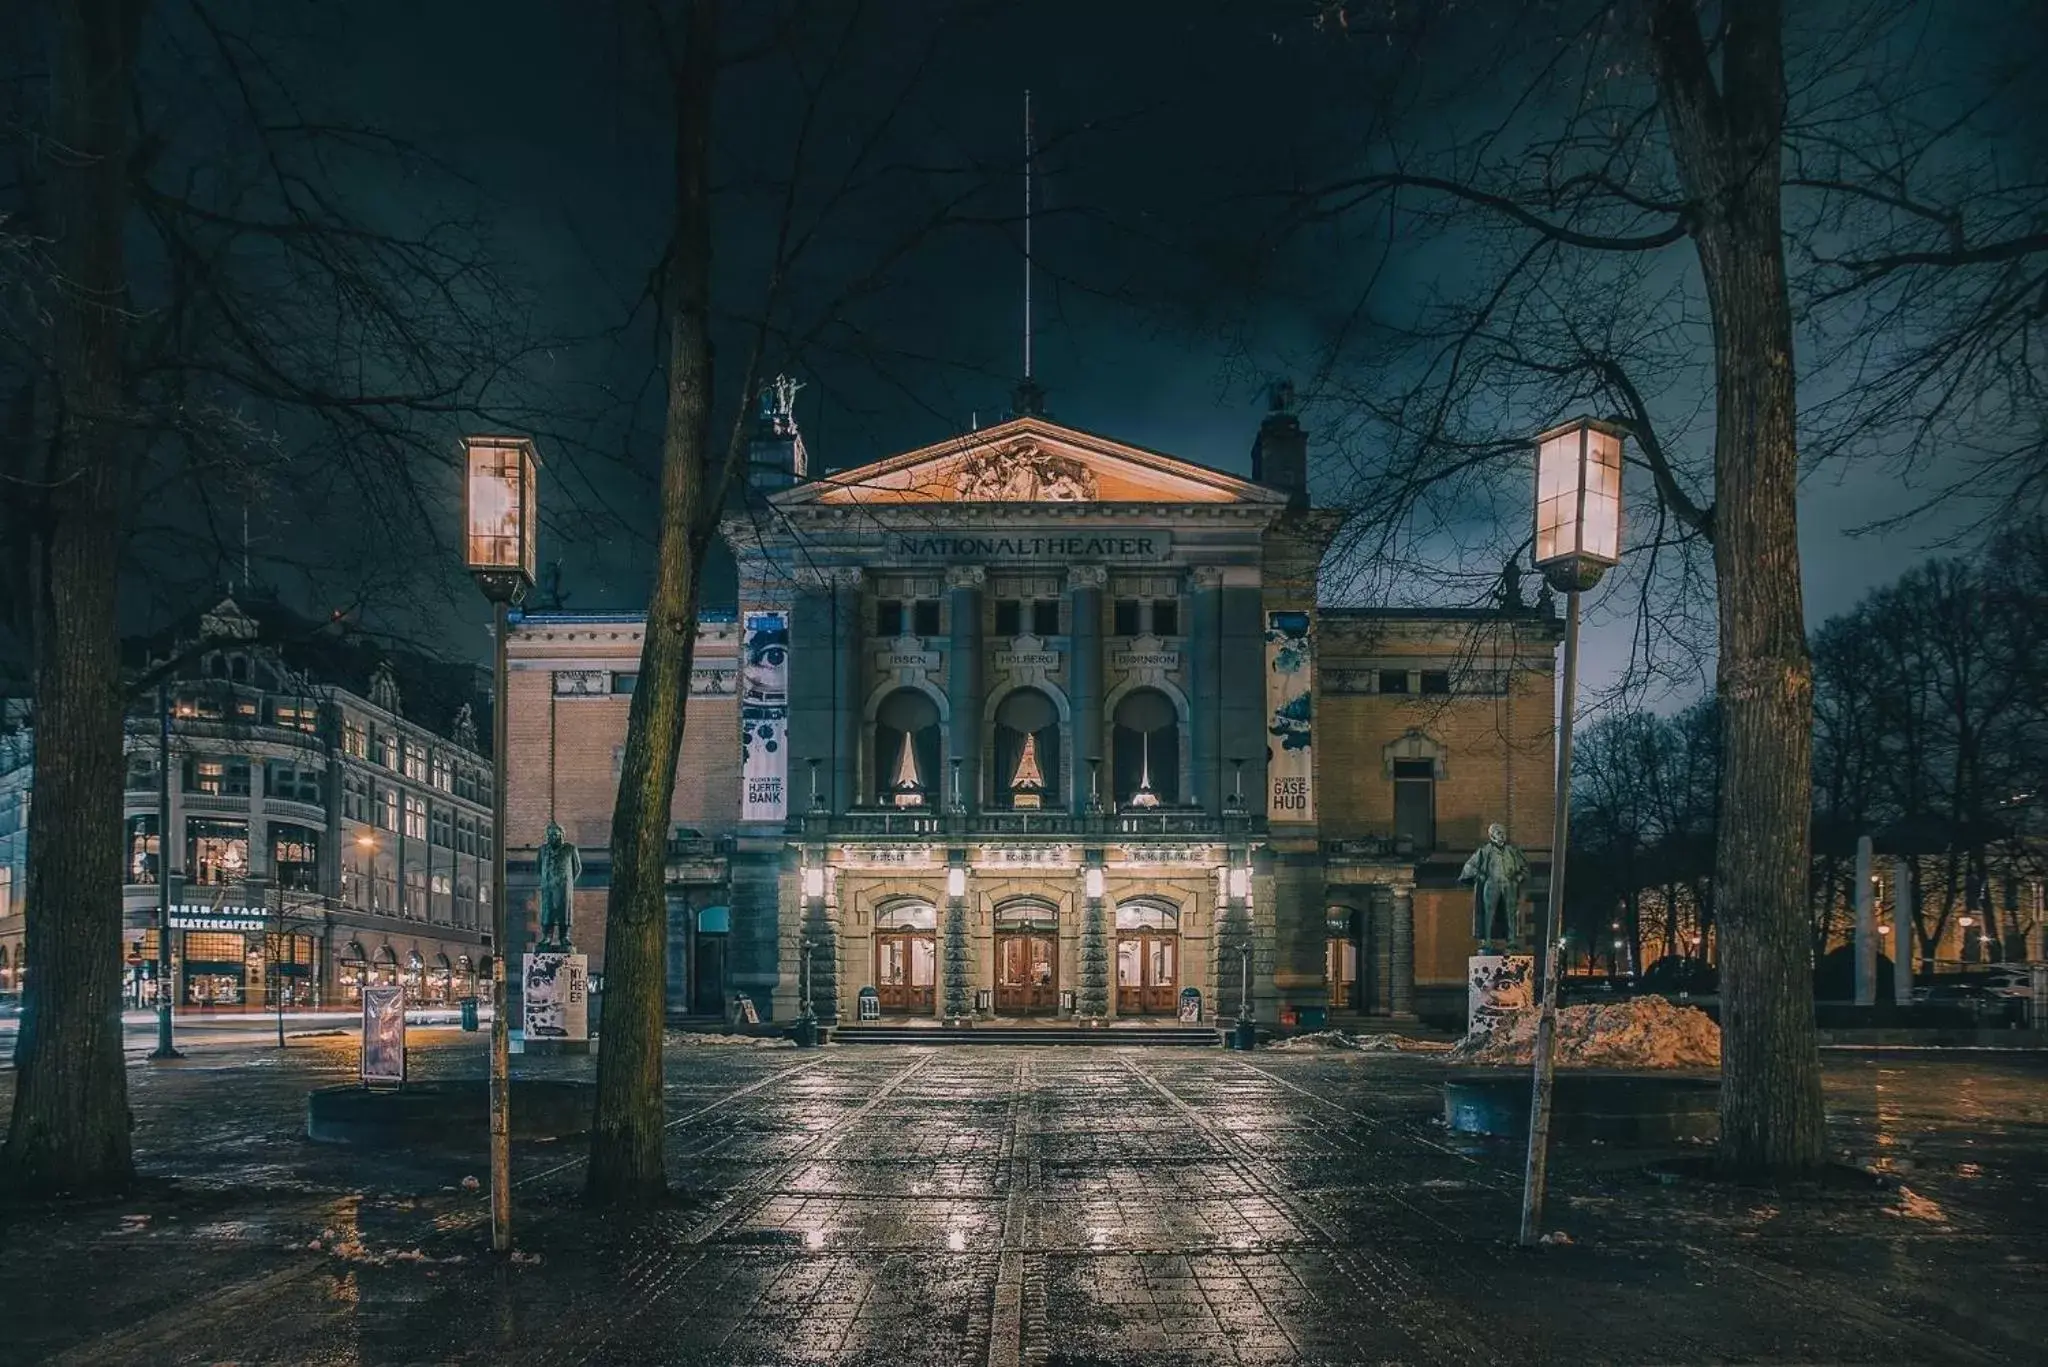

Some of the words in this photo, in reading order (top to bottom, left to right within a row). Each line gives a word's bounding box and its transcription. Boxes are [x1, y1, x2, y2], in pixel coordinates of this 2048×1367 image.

[897, 537, 1155, 555] NATIONALTHEATER
[889, 655, 927, 665] IBSEN
[749, 792, 781, 803] BANK
[1273, 795, 1306, 809] HUD
[158, 905, 211, 914] NNEN
[158, 918, 264, 930] HEATERCAFEEN
